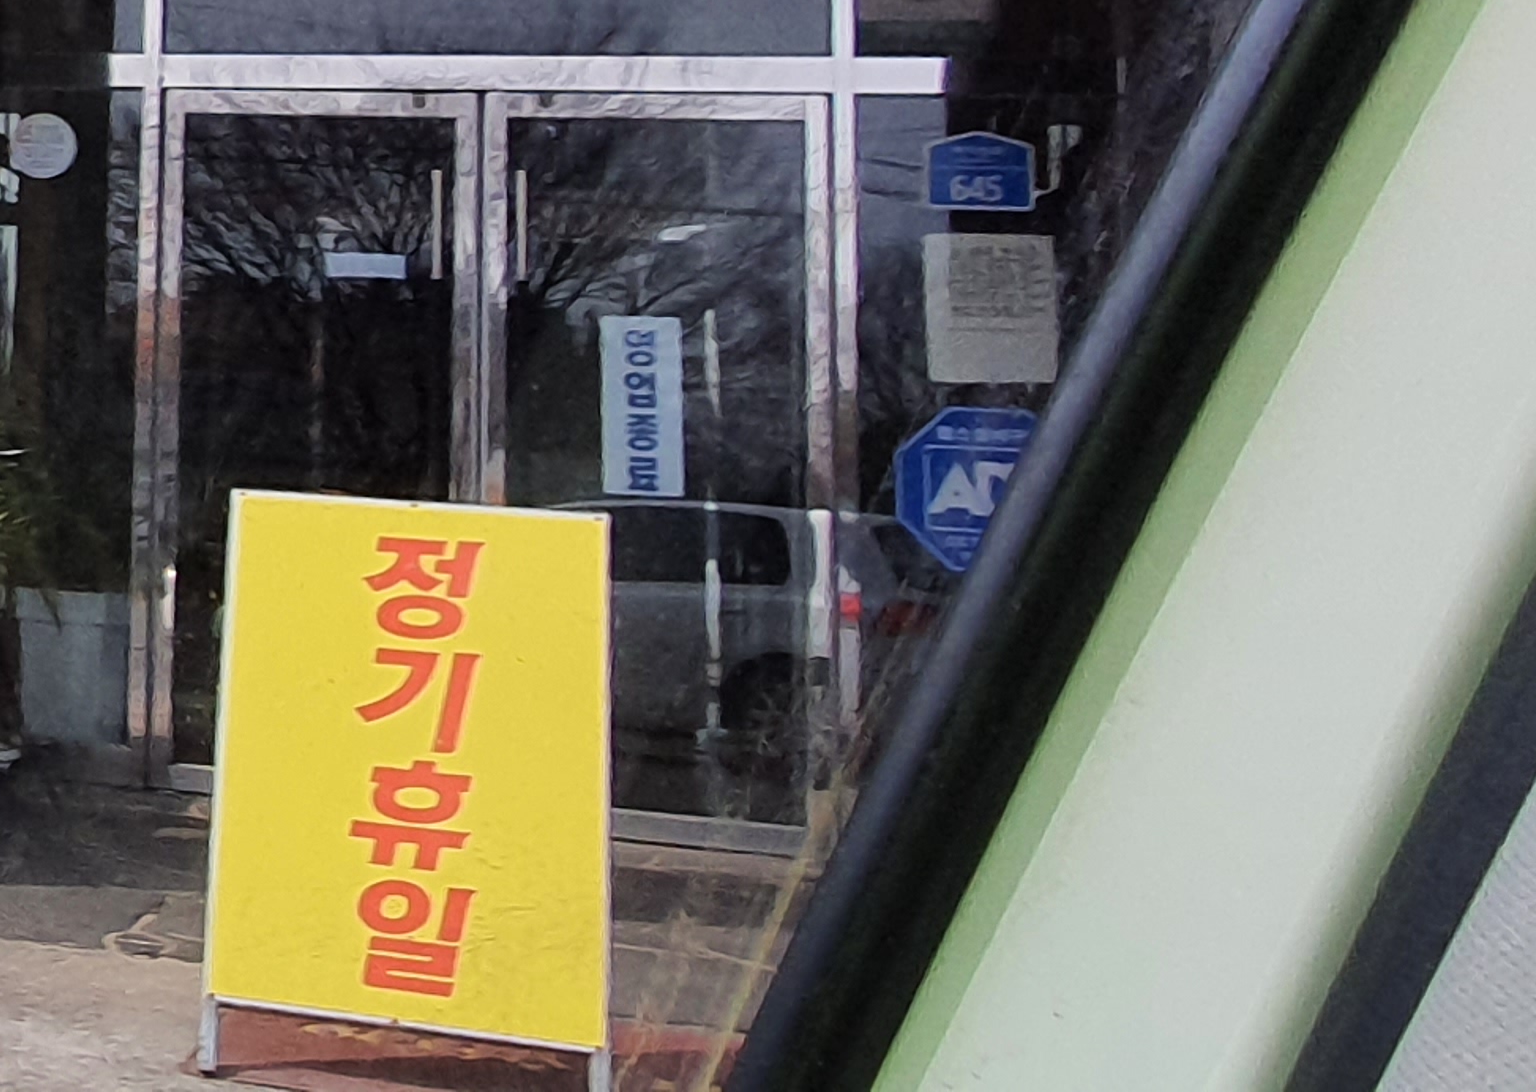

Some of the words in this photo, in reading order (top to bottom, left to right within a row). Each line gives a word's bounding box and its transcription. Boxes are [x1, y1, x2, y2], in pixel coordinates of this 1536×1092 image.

[949, 174, 1003, 202] 645
[624, 329, 658, 491] 영업종료
[928, 460, 1018, 517] AD
[348, 536, 486, 998] 정기휴일
